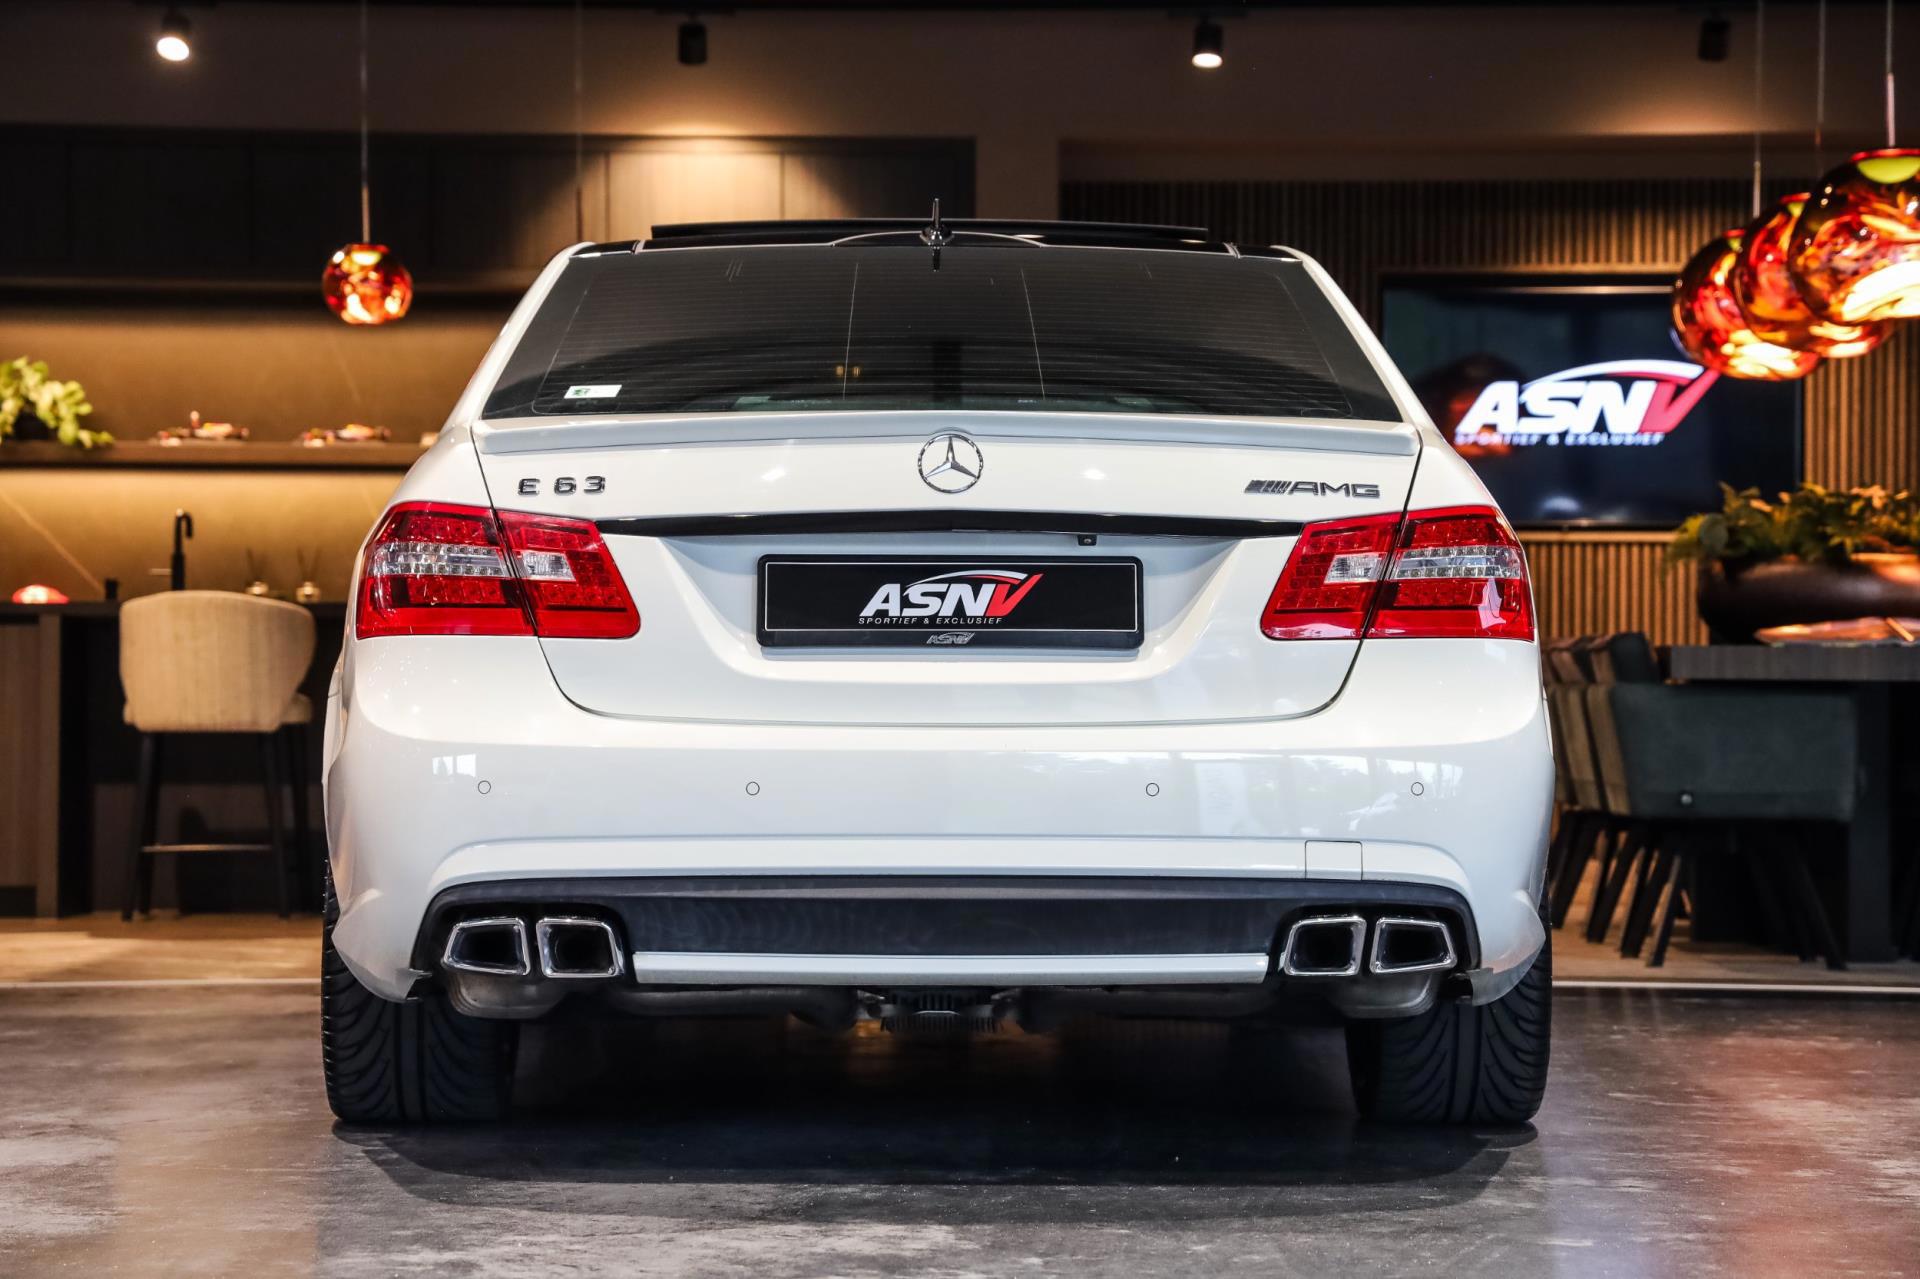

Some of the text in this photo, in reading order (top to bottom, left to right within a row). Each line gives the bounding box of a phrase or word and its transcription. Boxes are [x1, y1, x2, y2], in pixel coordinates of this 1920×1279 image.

[517, 475, 606, 496] E 63
[1288, 480, 1381, 499] AMG
[858, 617, 1003, 625] SPORTIEF & EXCLUSIEF
